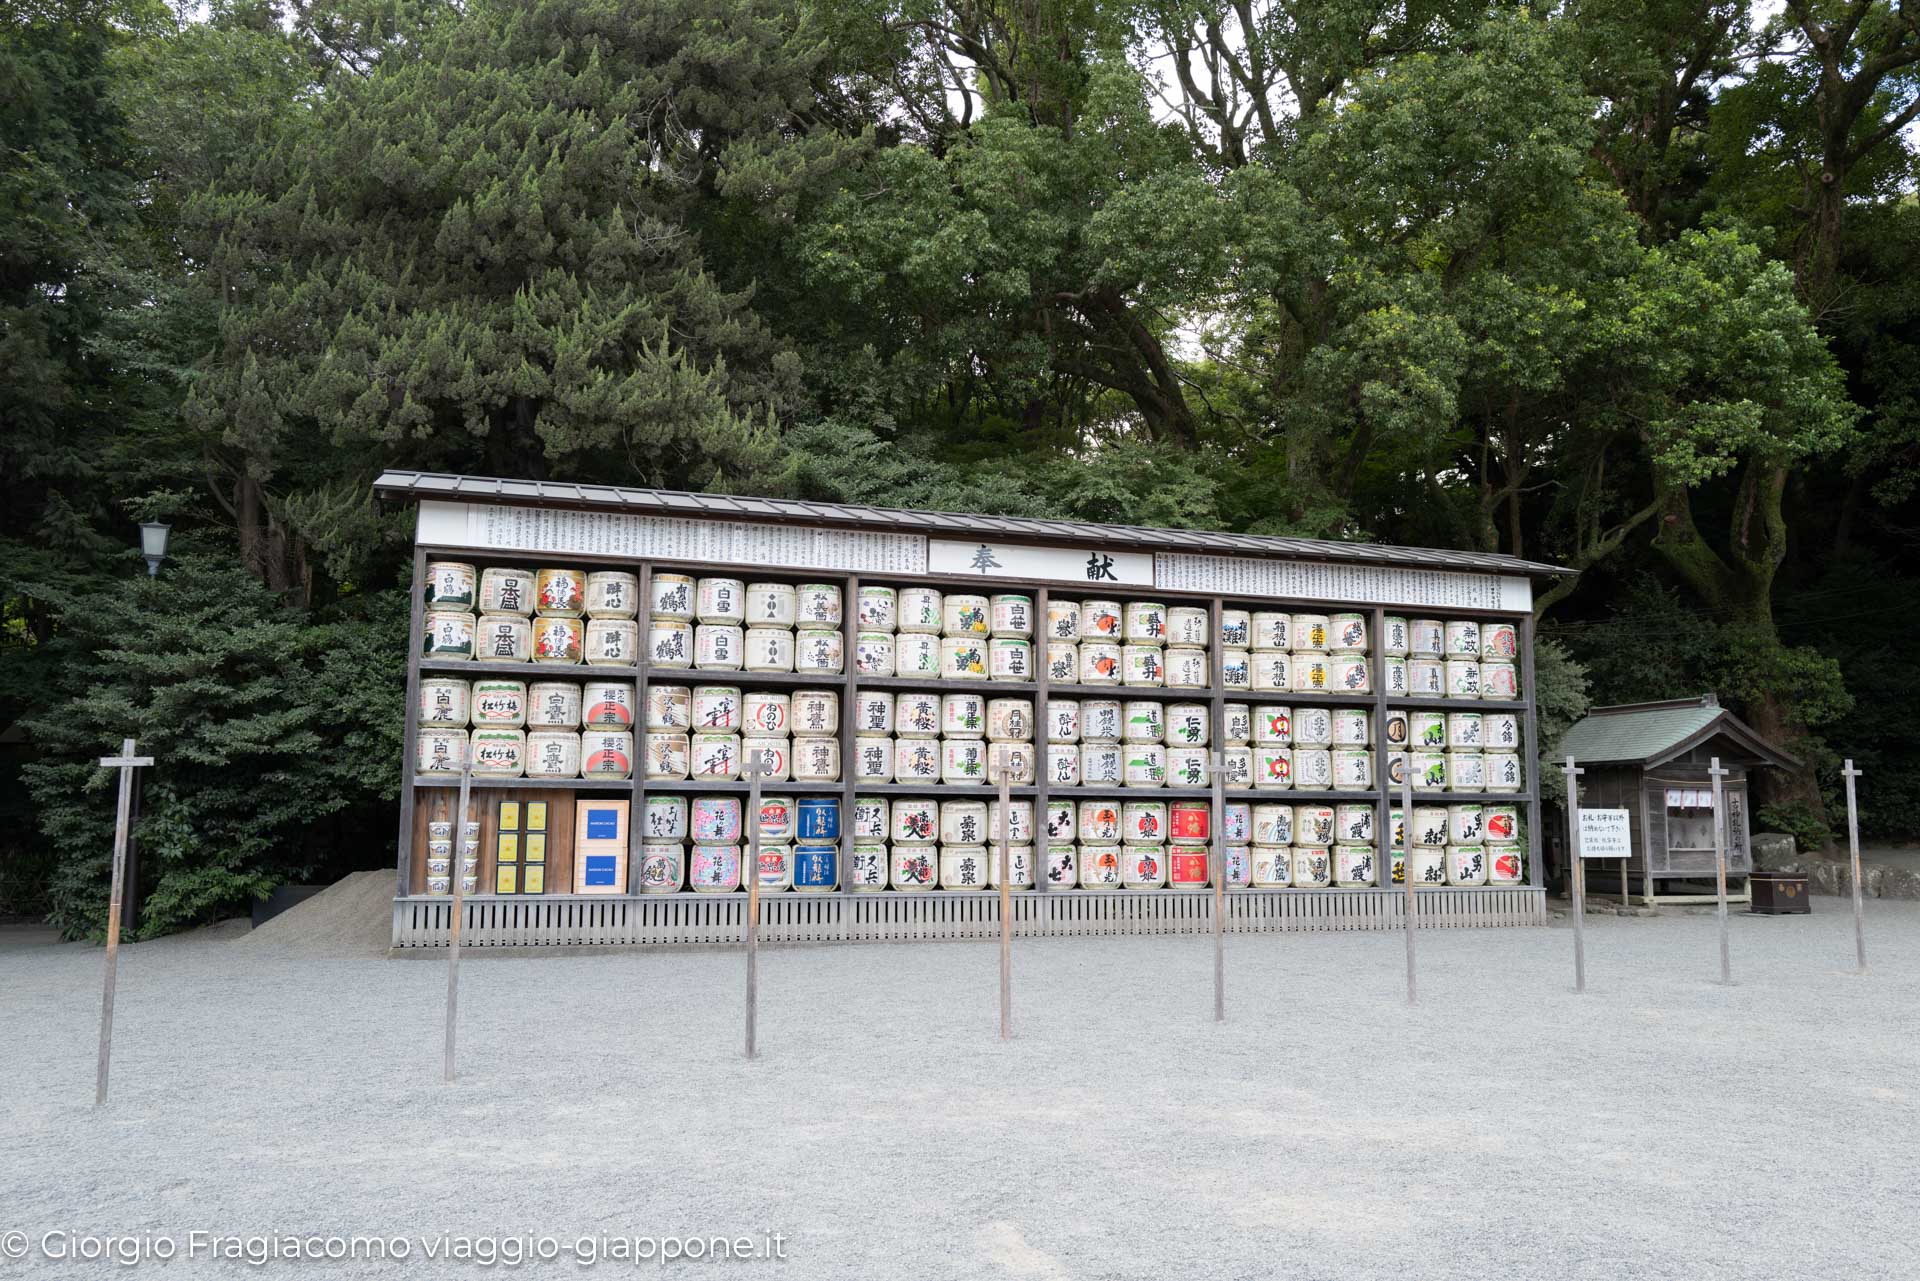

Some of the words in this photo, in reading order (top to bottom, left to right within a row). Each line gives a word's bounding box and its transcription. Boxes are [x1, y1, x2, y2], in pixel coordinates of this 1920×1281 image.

[970, 545, 1003, 574] 奉
[1087, 552, 1118, 581] 献
[500, 579, 520, 610] 日本盛
[717, 588, 731, 613] 白雪
[496, 626, 515, 657] 日本盛
[1273, 621, 1286, 647] 箱根山
[1463, 627, 1477, 653] 新政
[715, 635, 729, 660] 白雪
[1272, 661, 1285, 687] 箱根山
[1466, 668, 1479, 693] 新政
[482, 700, 518, 712] 松竹梅
[767, 703, 777, 730] ねのひ
[868, 702, 886, 730] 神聖
[913, 702, 935, 730] 黄桜
[966, 702, 977, 729] 菊正宗
[1186, 716, 1201, 742] 仁勇
[480, 749, 517, 760] 松竹梅
[864, 747, 883, 775] 神聖
[912, 747, 934, 775] 黄桜
[965, 748, 977, 776] 菊正宗
[1186, 758, 1200, 783] 仁勇
[713, 811, 725, 837] 花の舞
[711, 857, 723, 883] 花の舞
